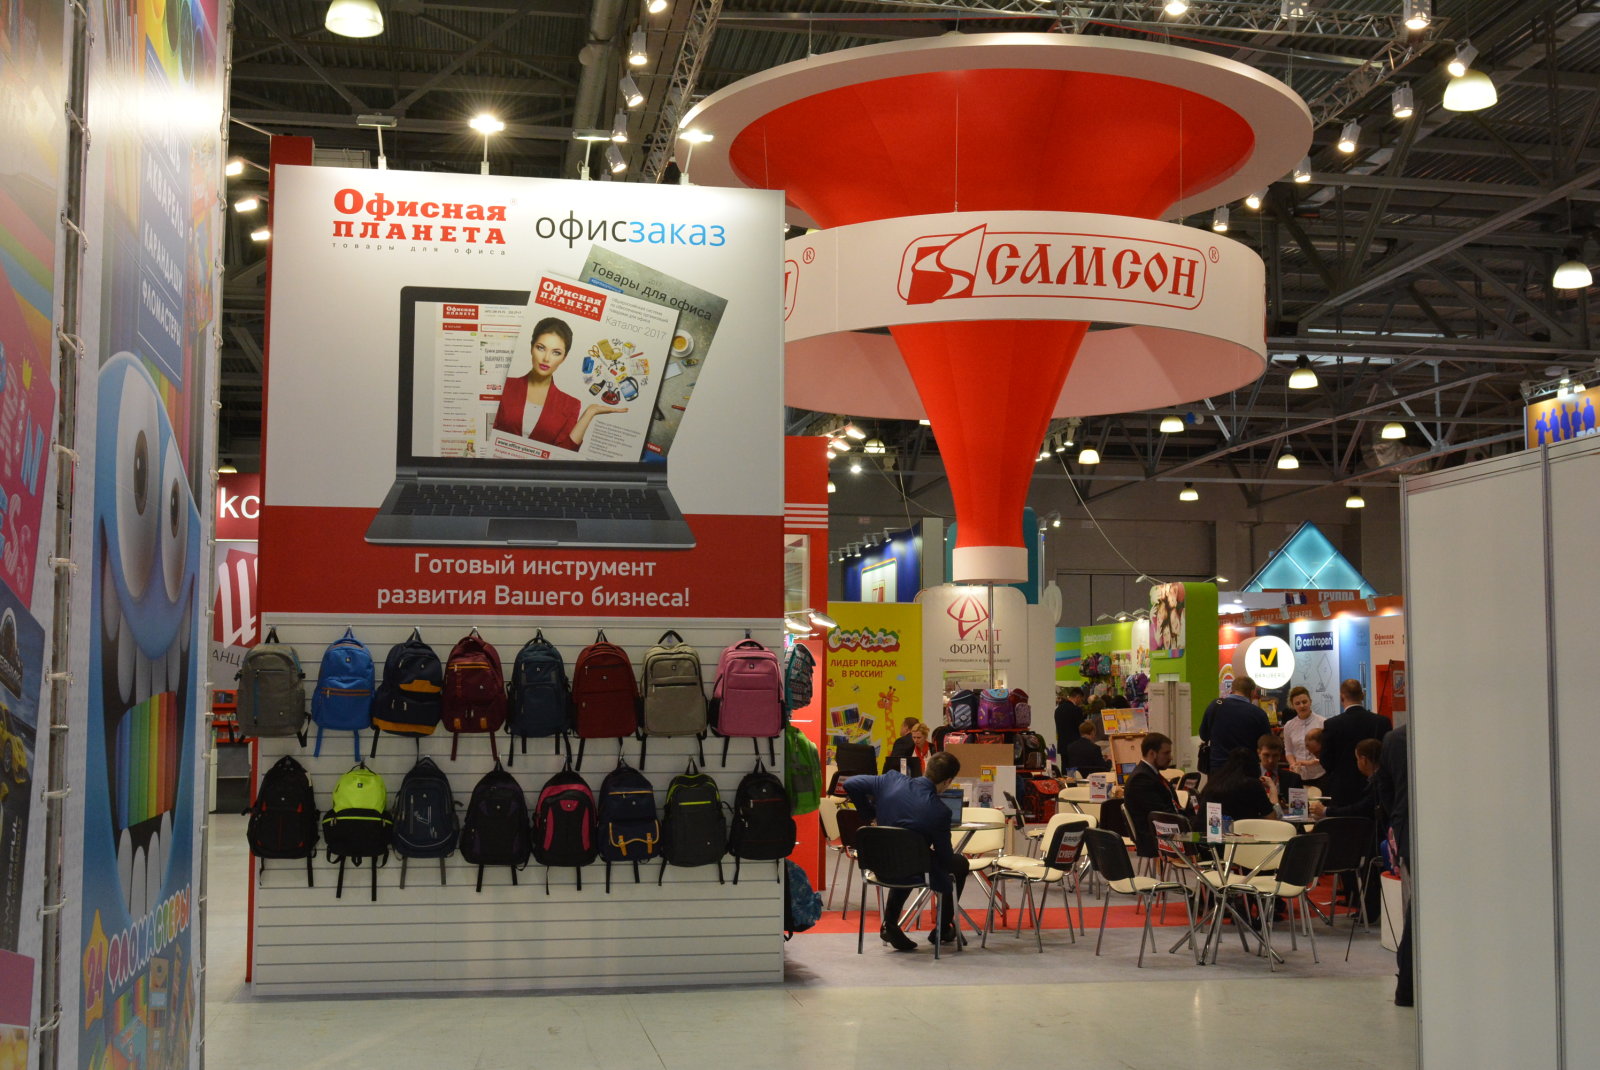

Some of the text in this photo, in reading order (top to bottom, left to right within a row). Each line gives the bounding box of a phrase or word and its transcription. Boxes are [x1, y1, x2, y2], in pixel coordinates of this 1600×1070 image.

[146, 152, 184, 238] АКВАРЕЛЬ
[333, 188, 507, 221] Офисная
[332, 220, 507, 244] ПЛАНЕТА
[535, 210, 726, 248] офисзаказ
[143, 221, 183, 297] КАРАНДАШИ
[332, 242, 395, 251] товары
[454, 247, 506, 256] офиса
[986, 242, 1200, 298] САМСОН
[540, 291, 599, 314] ПЛАНЕТА
[542, 281, 602, 306] Офисная
[591, 261, 640, 290] Товары
[641, 287, 668, 302] для
[669, 298, 712, 321] офиса
[141, 279, 181, 348] ФЛОМАСТЕРЫ
[605, 316, 667, 339] Каталог 2017
[414, 553, 656, 581] Готовый инструмент
[377, 585, 690, 609] развития Вашего бизнеса!
[1302, 634, 1333, 648] centropen
[830, 659, 897, 668] ЛИДЕР ПРОДАЖ
[841, 670, 883, 678] В РОССИИ!
[108, 883, 191, 994] ФЛОМАСТЕРЫ
[86, 941, 105, 1012] 24
